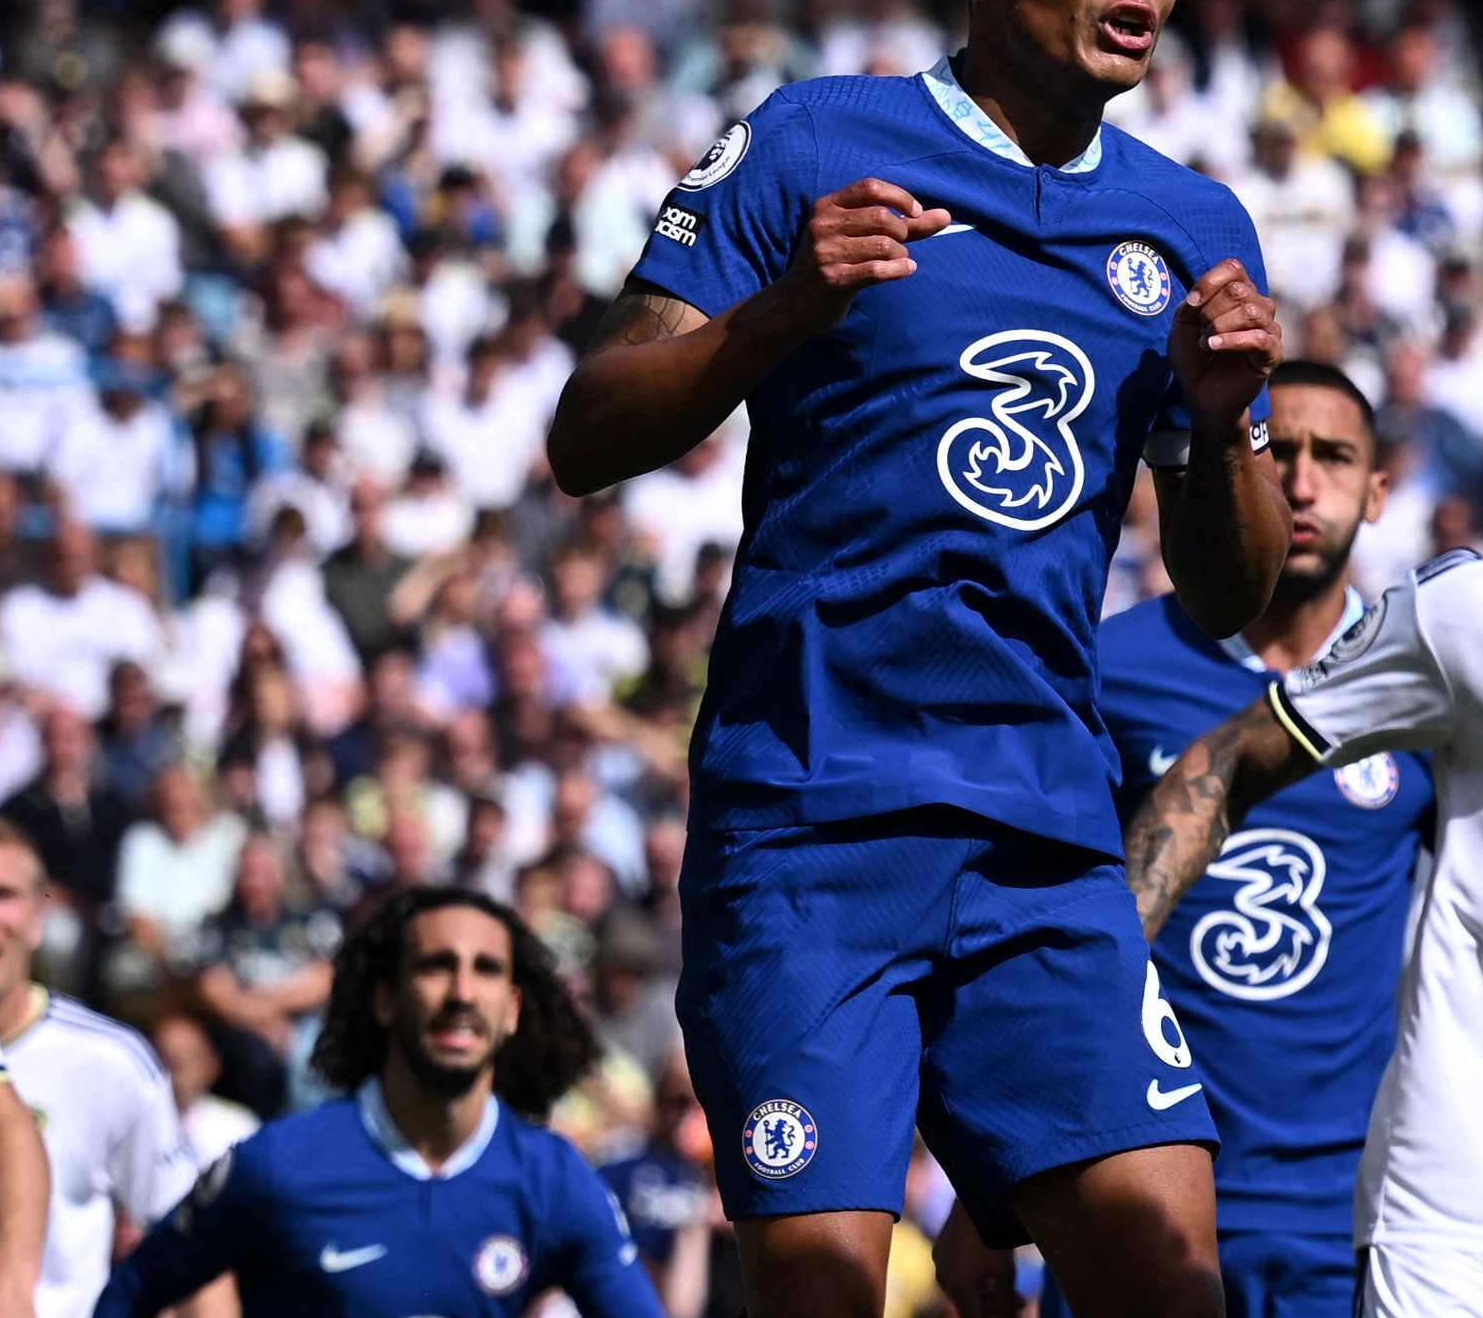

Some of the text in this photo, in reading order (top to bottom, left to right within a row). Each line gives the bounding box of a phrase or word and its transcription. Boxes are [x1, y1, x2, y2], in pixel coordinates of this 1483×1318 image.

[1119, 243, 1160, 265] CHELSEA
[1142, 959, 1192, 1068] 6
[753, 1102, 802, 1121] CHELSEA
